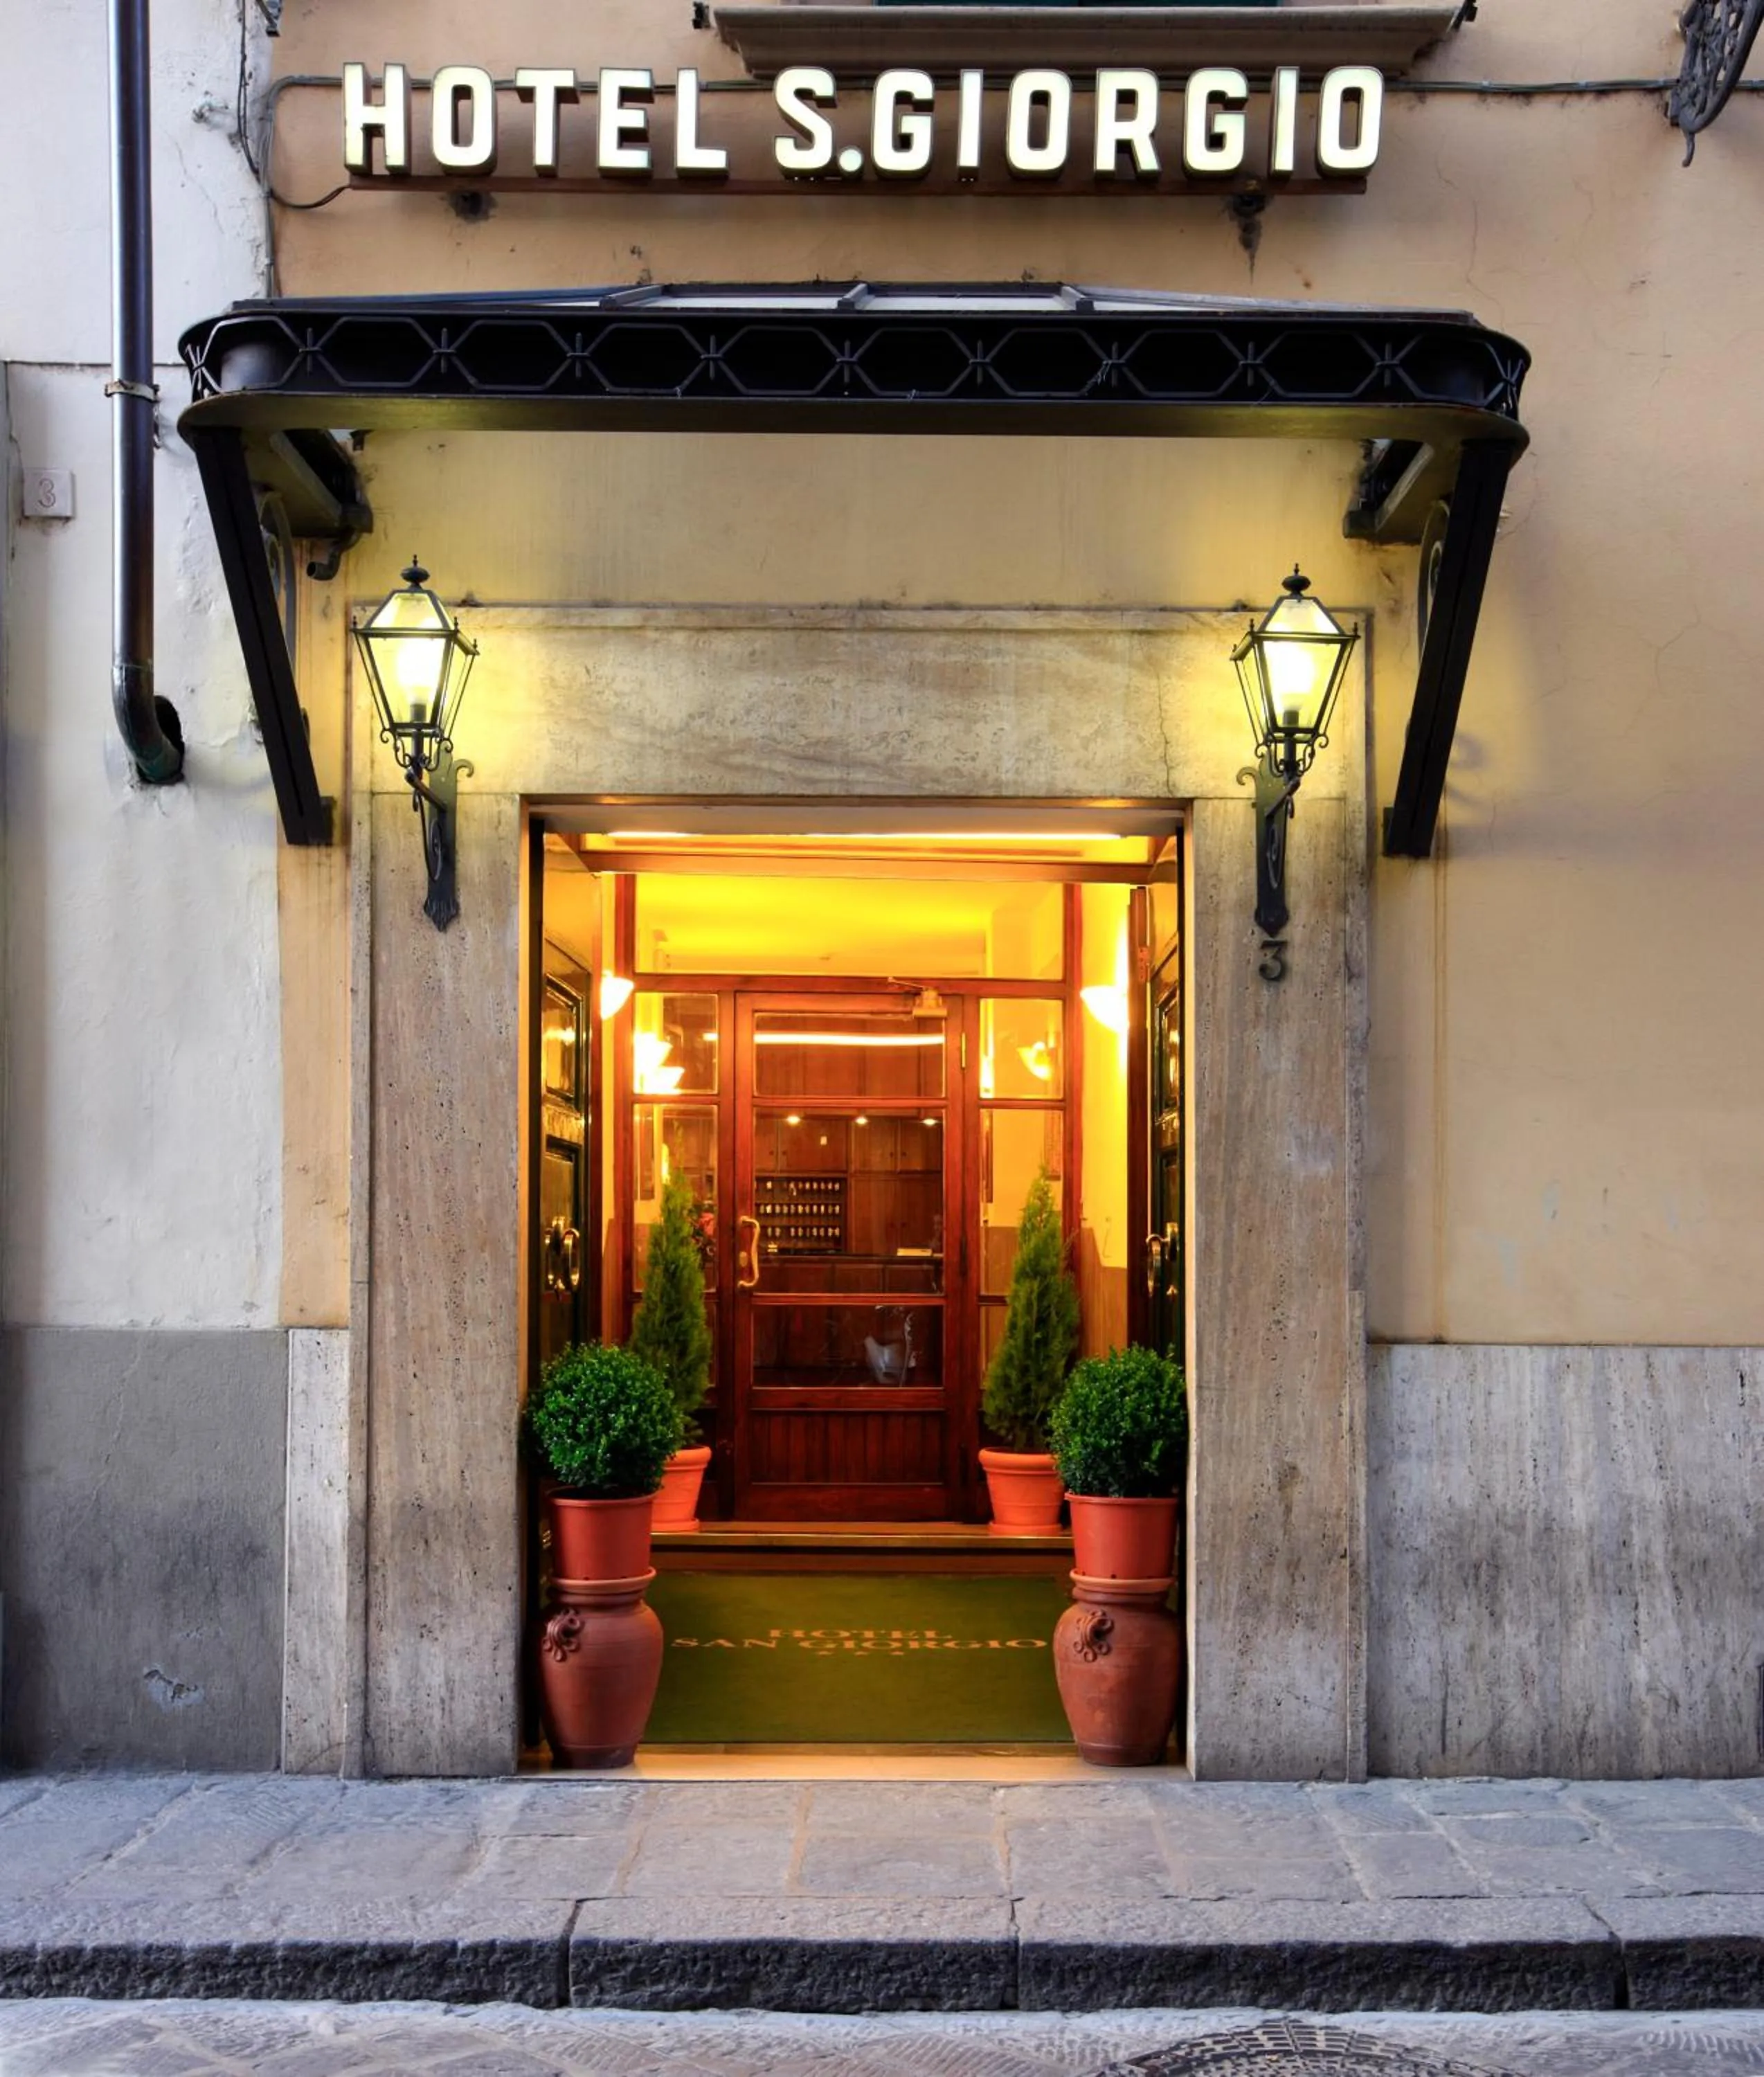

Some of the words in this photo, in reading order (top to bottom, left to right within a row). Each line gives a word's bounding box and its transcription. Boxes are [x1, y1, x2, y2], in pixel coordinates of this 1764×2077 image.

[343, 62, 727, 175] HOTEL
[38, 478, 56, 507] 3
[1259, 940, 1287, 981] 3
[671, 1638, 777, 1648] SAN
[798, 1639, 1047, 1649] GIORGIO
[768, 1629, 950, 1639] HOTEL
